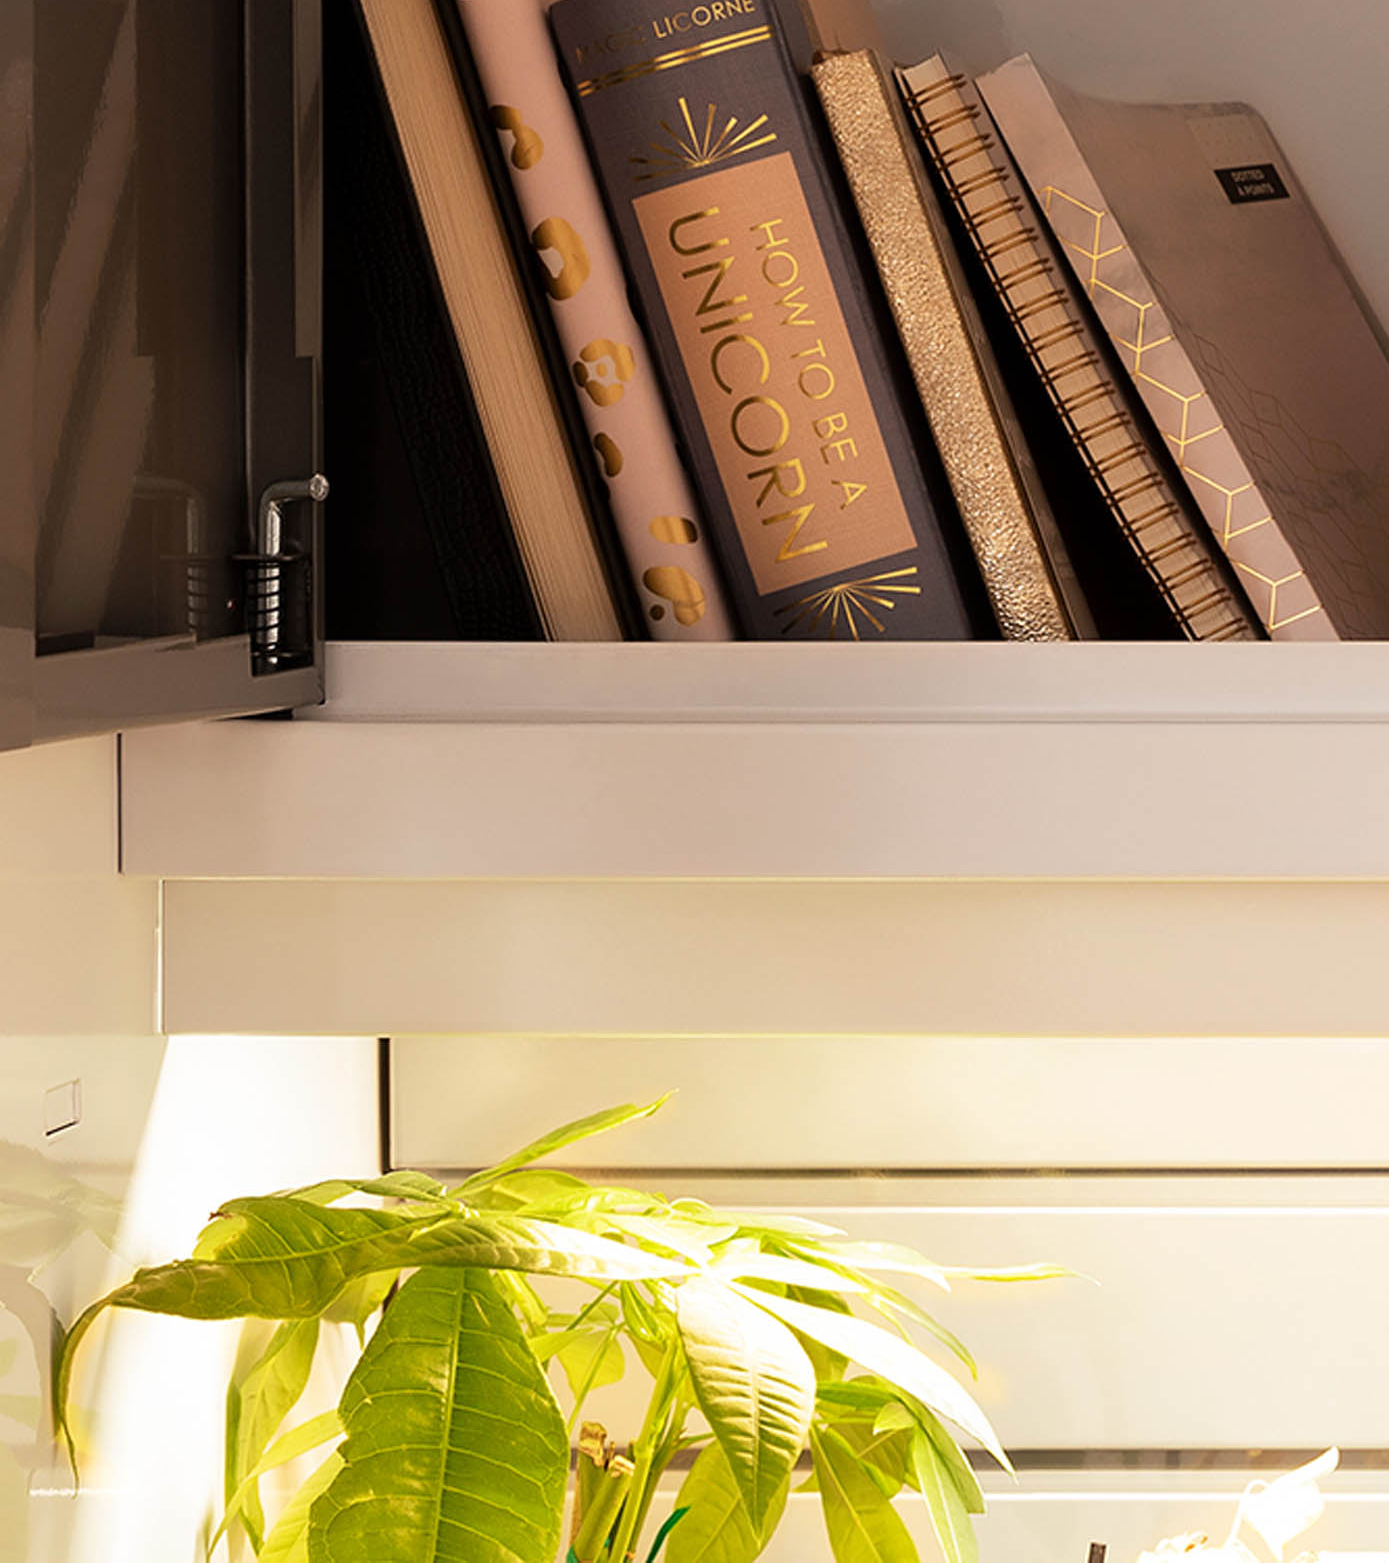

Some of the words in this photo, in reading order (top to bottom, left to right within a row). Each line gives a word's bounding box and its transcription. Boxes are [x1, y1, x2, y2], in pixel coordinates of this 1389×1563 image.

[750, 218, 816, 326] HOW
[669, 206, 828, 563] UNICORN
[791, 339, 835, 400] TO
[812, 411, 859, 465] BE
[831, 479, 868, 510] A
